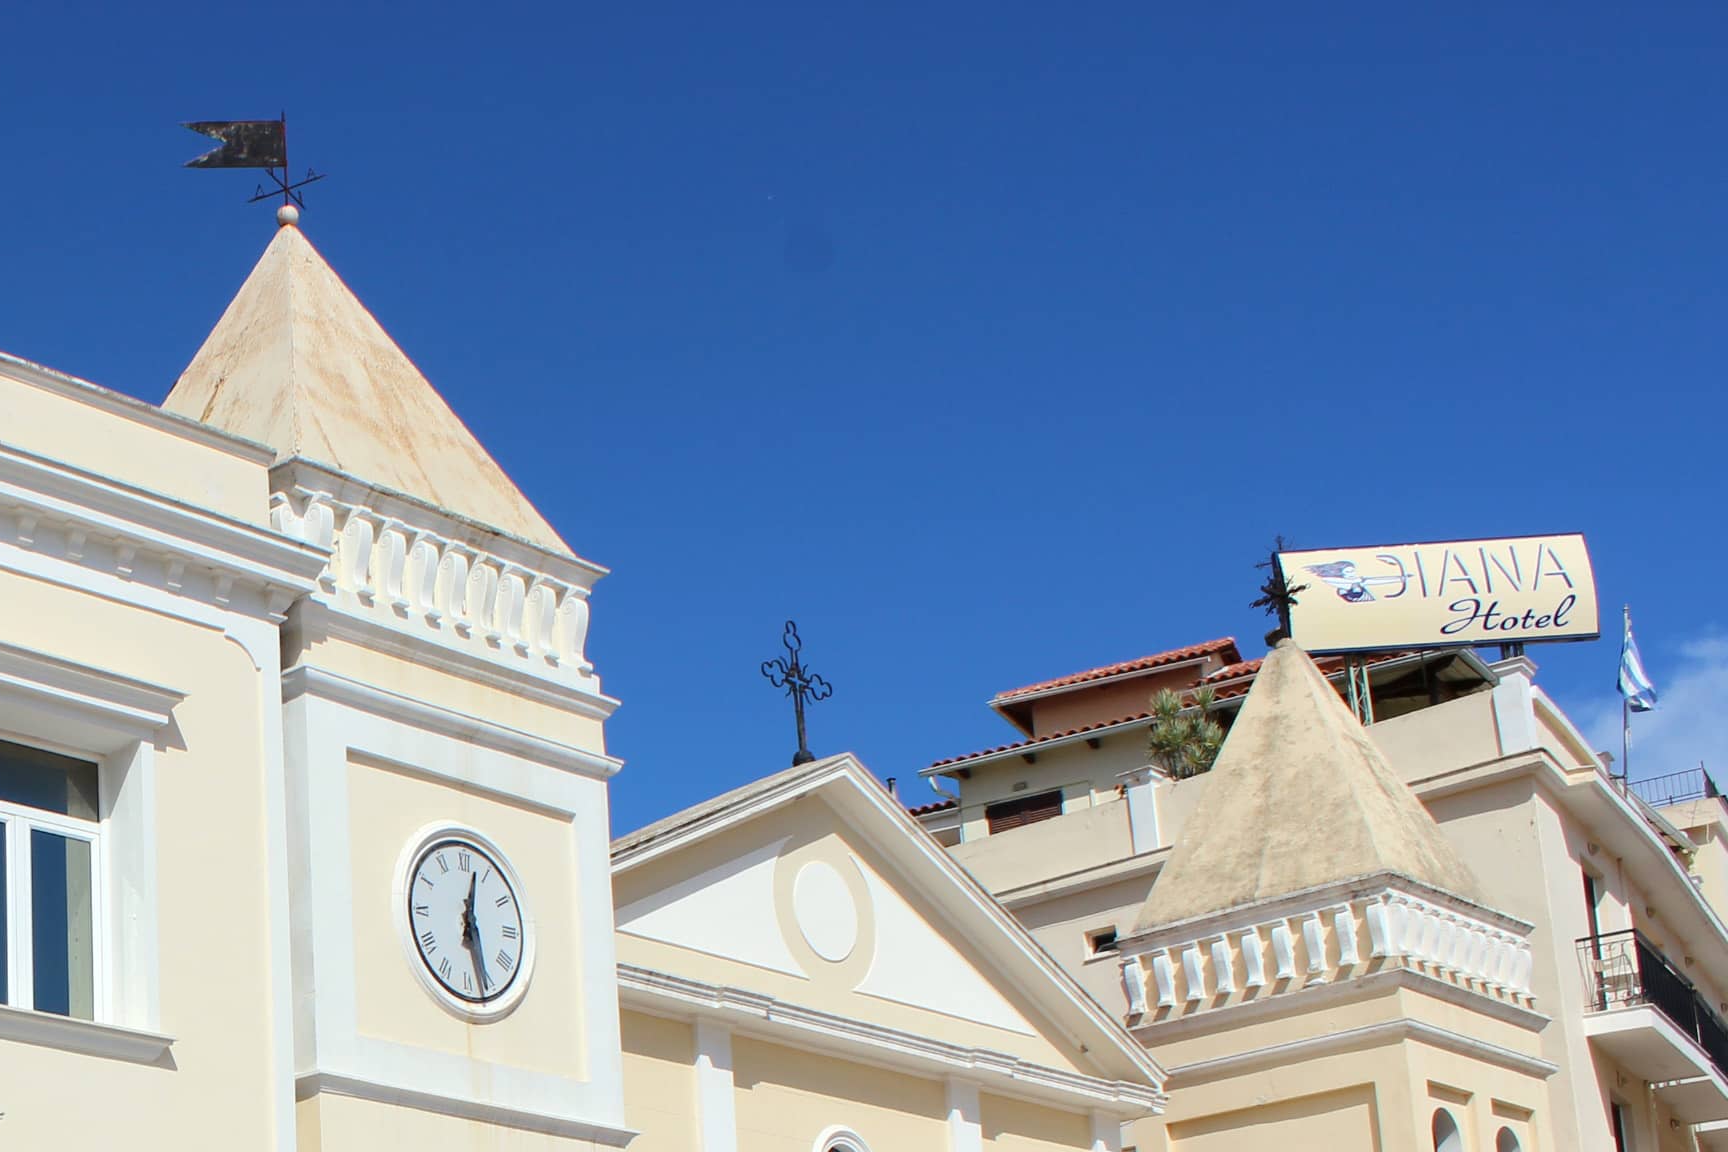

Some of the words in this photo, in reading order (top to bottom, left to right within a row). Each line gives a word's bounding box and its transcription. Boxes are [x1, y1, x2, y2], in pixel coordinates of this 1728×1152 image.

[1375, 543, 1575, 599] DIANA
[1440, 594, 1576, 635] Hotel
[501, 925, 517, 940] III
